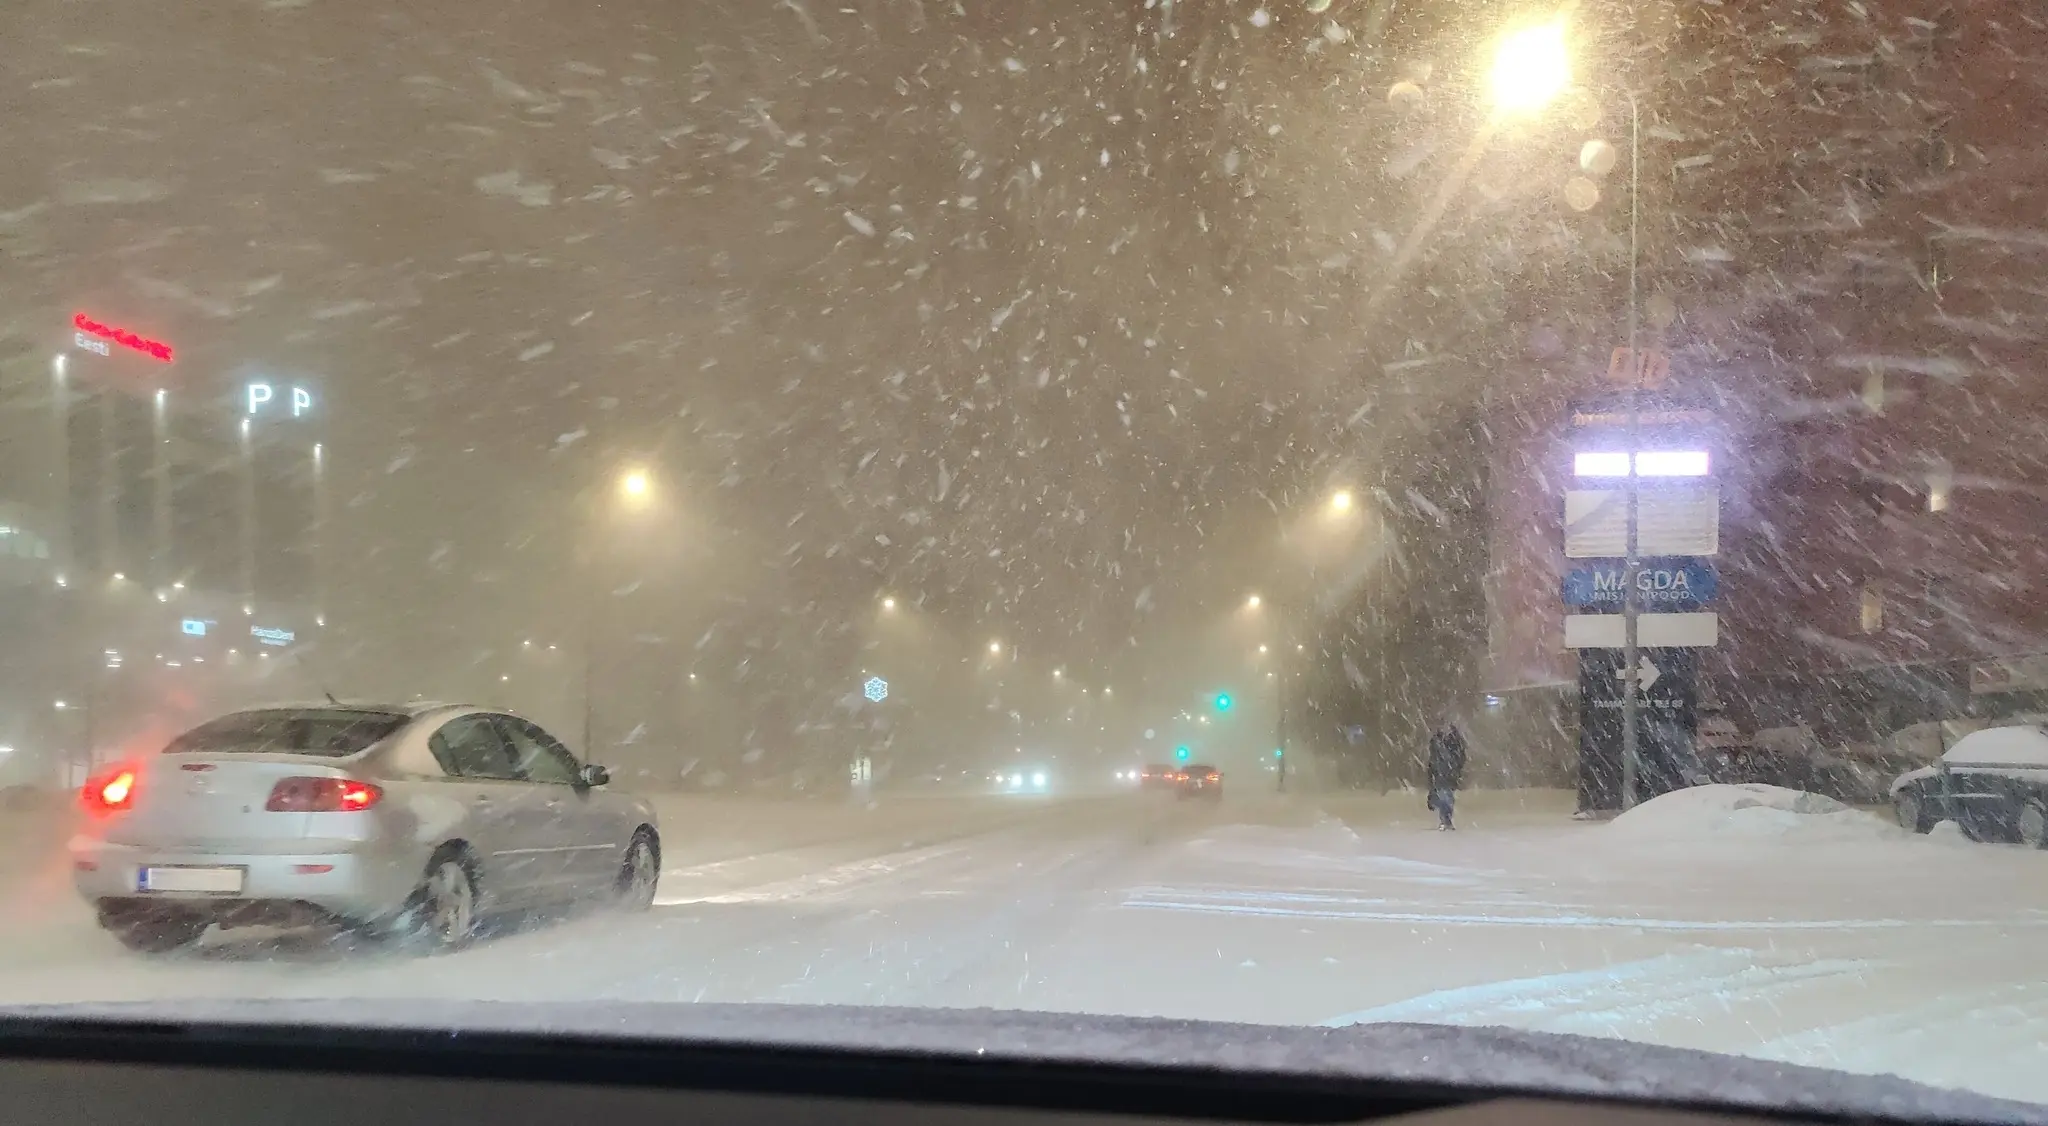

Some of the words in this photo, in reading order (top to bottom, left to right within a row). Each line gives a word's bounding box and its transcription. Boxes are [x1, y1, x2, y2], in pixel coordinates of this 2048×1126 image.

[75, 332, 109, 357] Eesti
[249, 384, 272, 414] P
[294, 387, 311, 416] P
